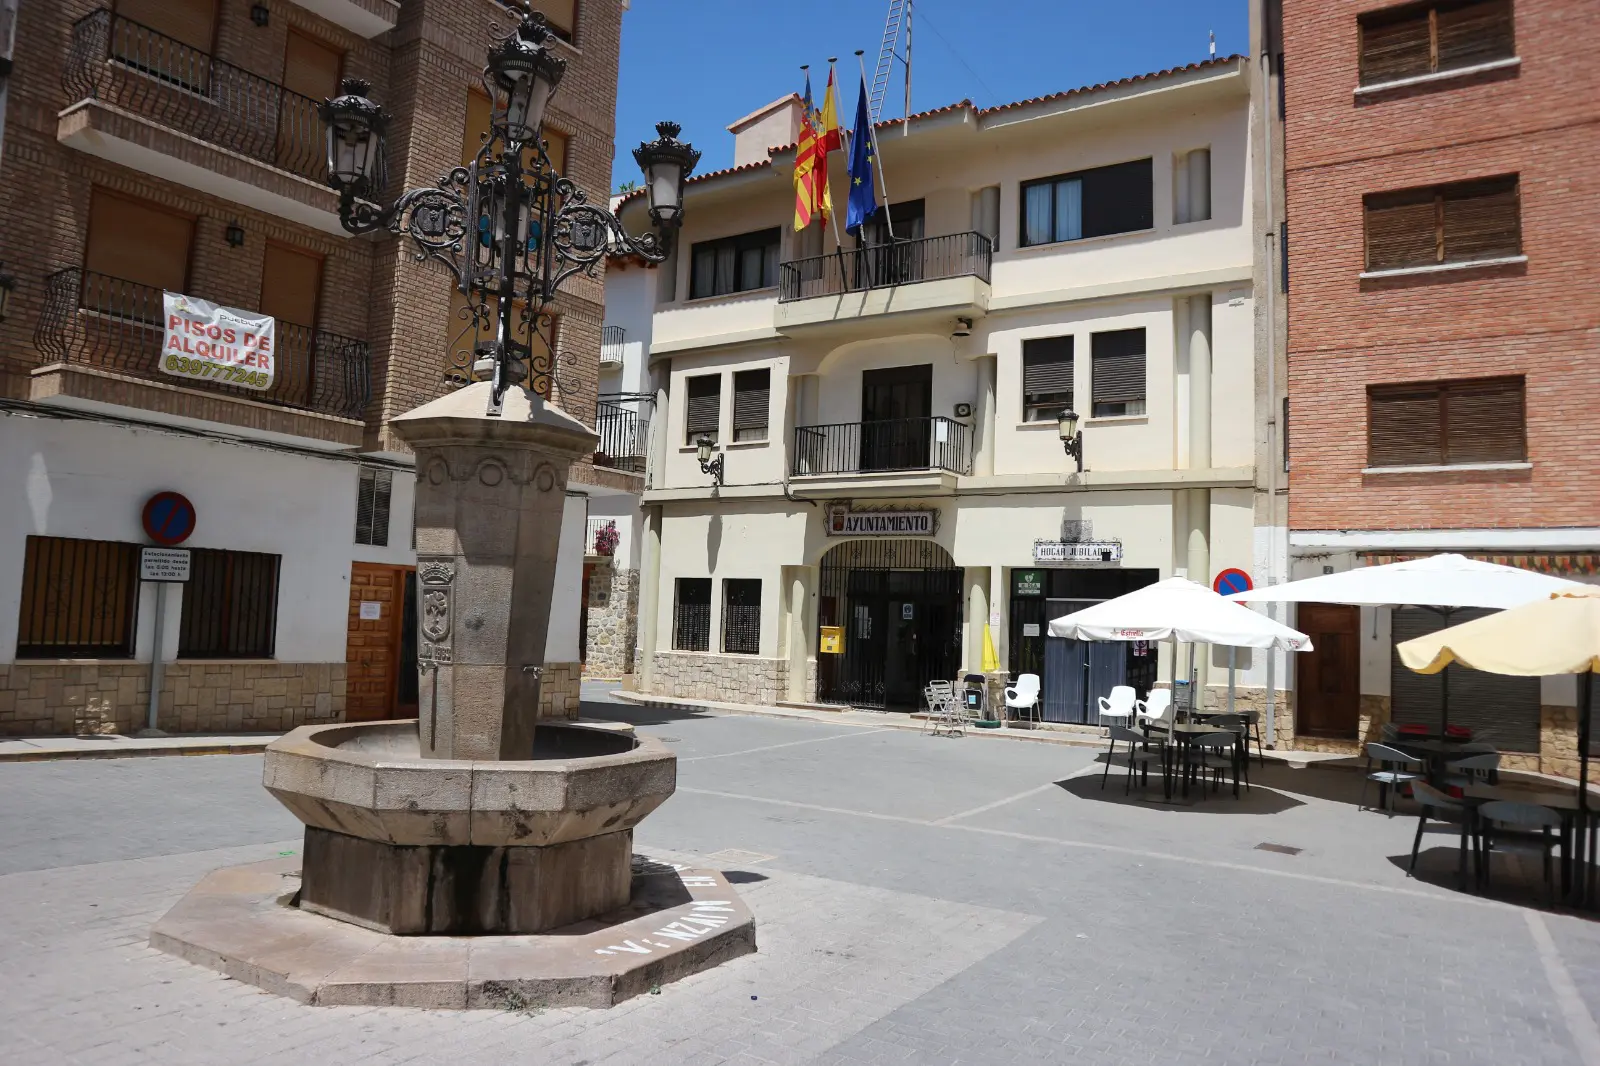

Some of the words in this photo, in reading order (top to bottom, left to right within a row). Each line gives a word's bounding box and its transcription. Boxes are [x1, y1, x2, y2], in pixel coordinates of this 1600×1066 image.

[168, 314, 236, 344] PISOS
[243, 332, 270, 351] DE
[167, 334, 270, 369] ALQUILER
[165, 354, 269, 387] 639777245
[845, 515, 928, 532] AYUNTAMIENTO
[1040, 547, 1066, 556] HOGAR
[1120, 628, 1144, 637] Estrella
